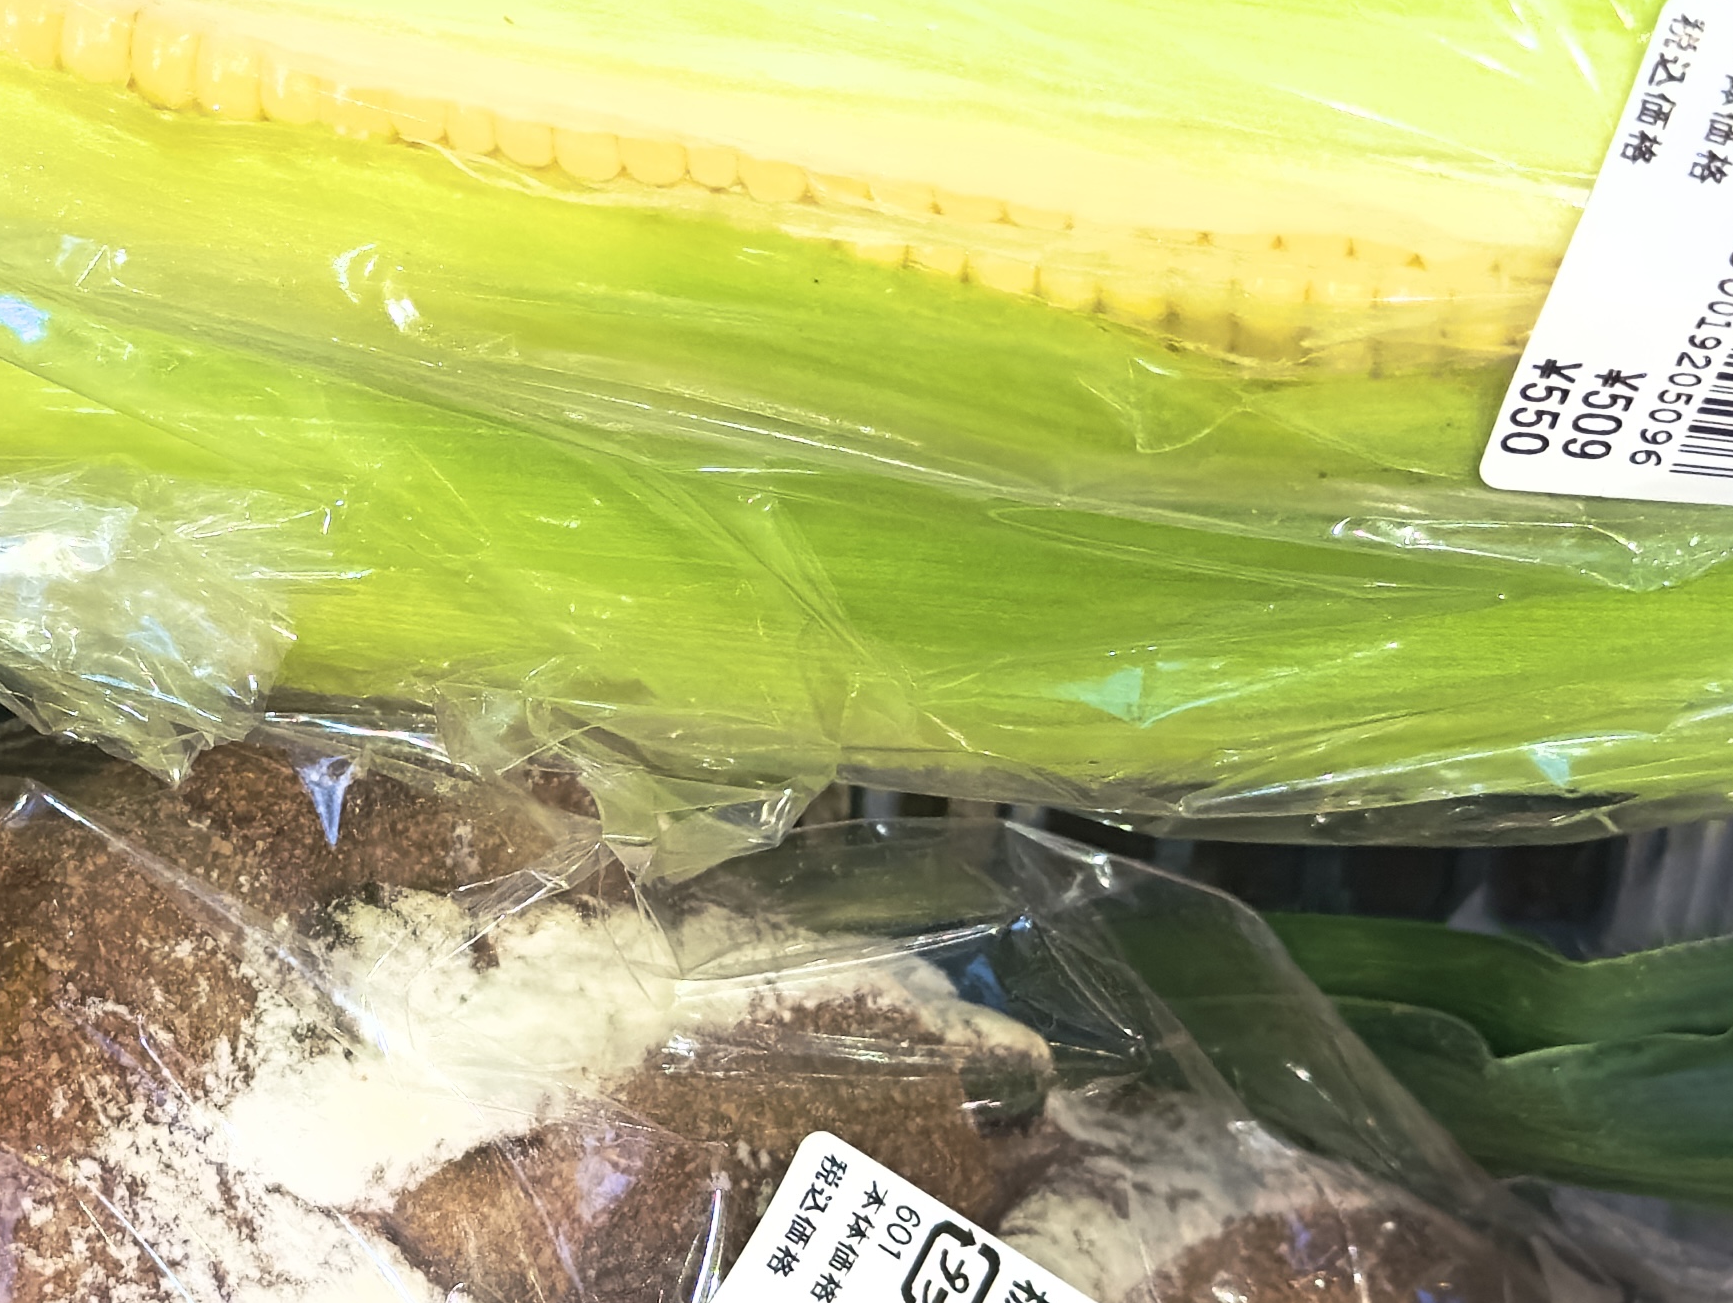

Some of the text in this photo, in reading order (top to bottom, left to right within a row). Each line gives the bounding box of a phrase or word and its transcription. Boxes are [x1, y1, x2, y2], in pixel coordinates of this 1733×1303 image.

[1499, 13, 1706, 457] 税込価格 ¥550
[1561, 367, 1649, 461] ¥509
[765, 1153, 849, 1279] 税込価格
[876, 1204, 921, 1261] 601
